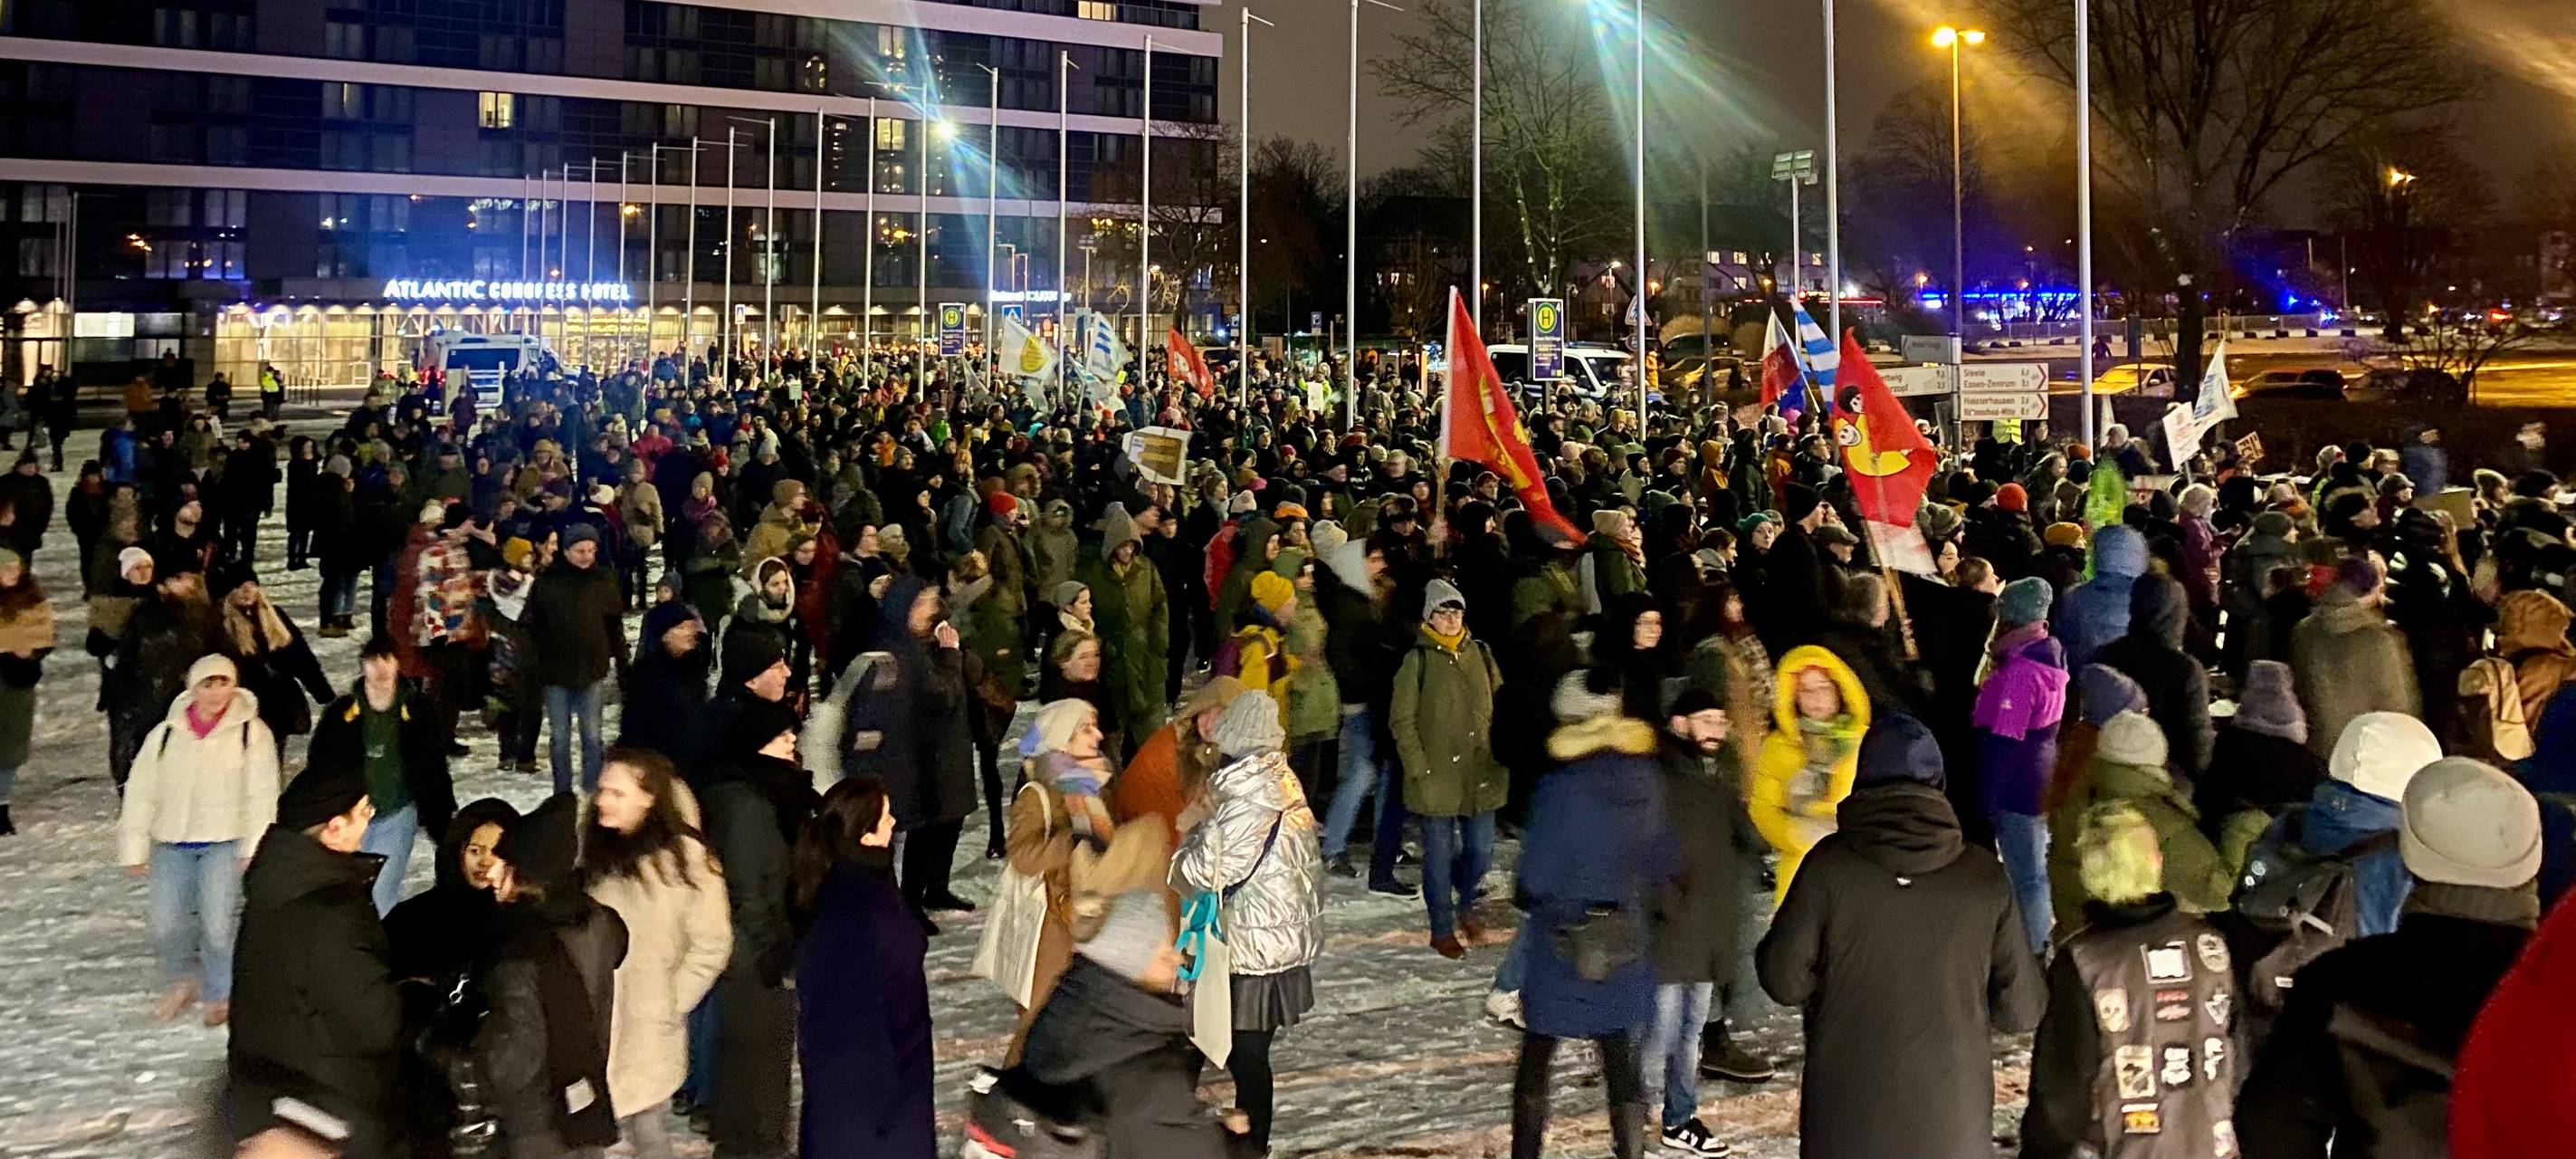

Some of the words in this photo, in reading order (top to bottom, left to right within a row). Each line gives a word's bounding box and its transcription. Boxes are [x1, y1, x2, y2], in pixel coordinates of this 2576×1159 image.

[382, 279, 487, 300] ATLANTIC
[948, 311, 956, 323] H
[1541, 309, 1550, 326] H
[1963, 369, 1986, 377] Steele
[1963, 378, 2017, 388] Essen-Zentrum
[1963, 396, 2015, 406] Holsterhausen
